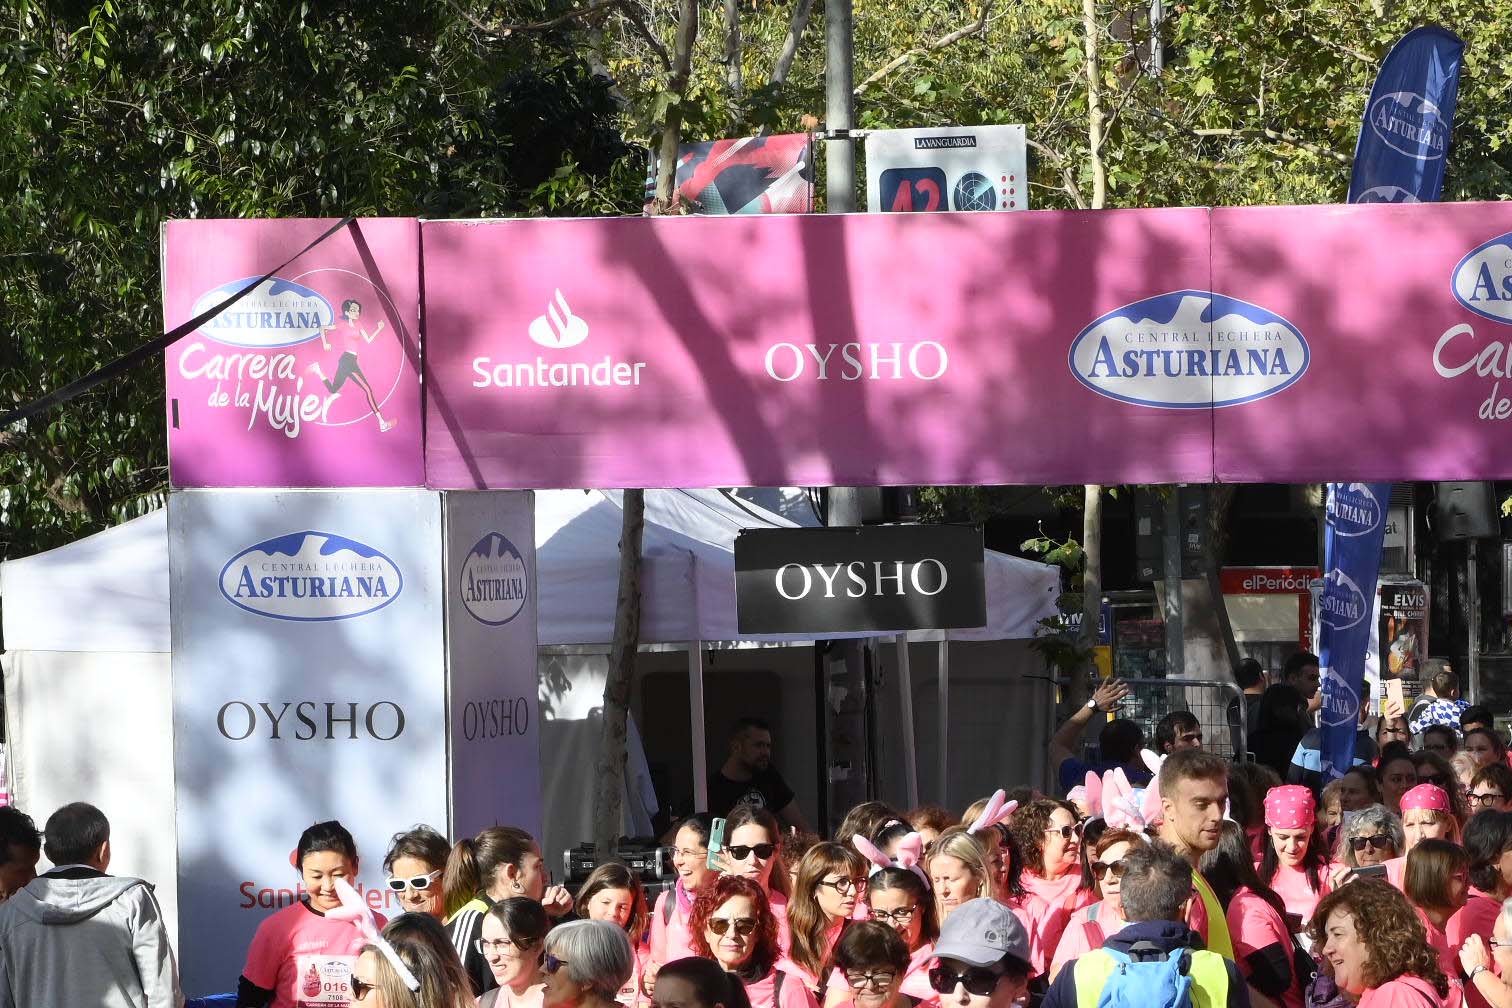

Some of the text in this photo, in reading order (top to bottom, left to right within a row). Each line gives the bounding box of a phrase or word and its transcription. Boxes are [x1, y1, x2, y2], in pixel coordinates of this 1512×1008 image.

[1124, 331, 1199, 344] CENTRAL
[178, 343, 296, 381] Carrera
[472, 355, 646, 388] Santander
[764, 340, 948, 382] OYSHO
[1088, 335, 1291, 379] ASTURIANA
[207, 377, 342, 439] de la Mujer
[1478, 381, 1512, 420] de
[233, 564, 390, 599] ASTURIANA
[261, 562, 318, 573] CENTRAL
[465, 566, 524, 602] ASTURIANA
[775, 558, 949, 600] OYSHO
[1393, 594, 1425, 607] ELVIS
[216, 700, 406, 741] OYSHO
[462, 696, 530, 742] OYSHO
[239, 881, 397, 910] Santer
[323, 982, 348, 992] 016
